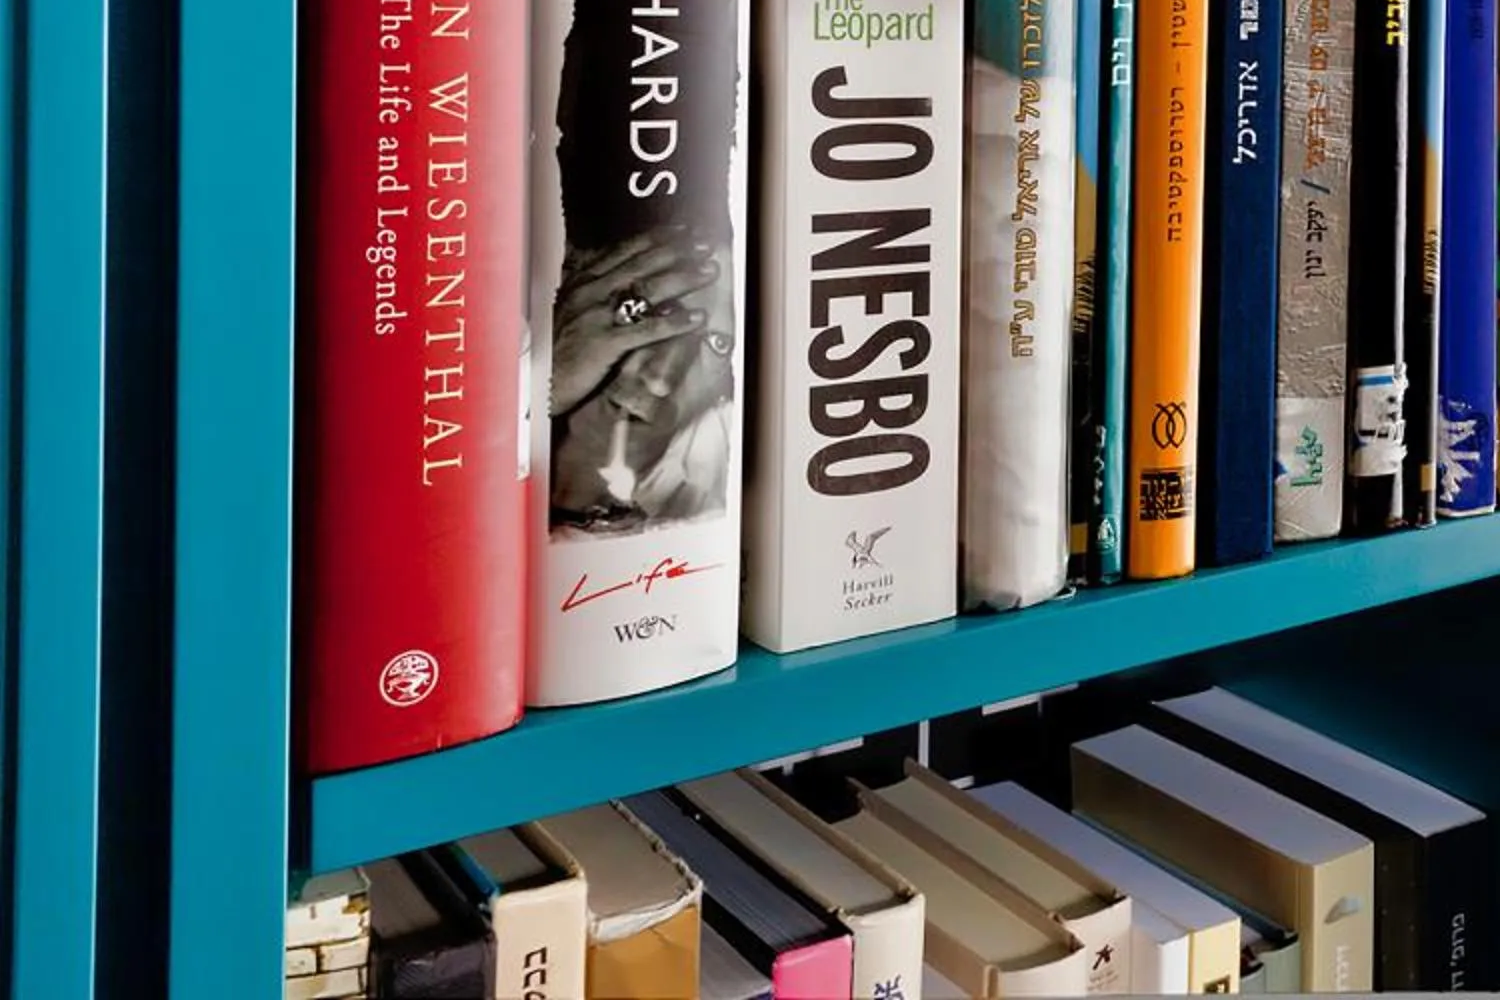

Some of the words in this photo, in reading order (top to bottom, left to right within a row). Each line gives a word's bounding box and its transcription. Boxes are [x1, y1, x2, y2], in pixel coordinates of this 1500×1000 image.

[812, 2, 935, 51] Leopard
[378, 56, 412, 124] Life
[1111, 36, 1132, 87] וים
[809, 64, 936, 183] JO
[1014, 75, 1043, 125] של
[1231, 60, 1259, 165] אדריכל
[377, 133, 410, 193] and
[1012, 127, 1042, 226] אריאל
[364, 201, 409, 336] Legends
[421, 71, 470, 487] WIESENTHAL
[1012, 228, 1040, 294] טובי
[805, 207, 933, 498] NESBO
[560, 558, 726, 614] Life
[842, 573, 895, 597] Harvill
[843, 589, 894, 614] Secker
[613, 614, 679, 647] W&N
